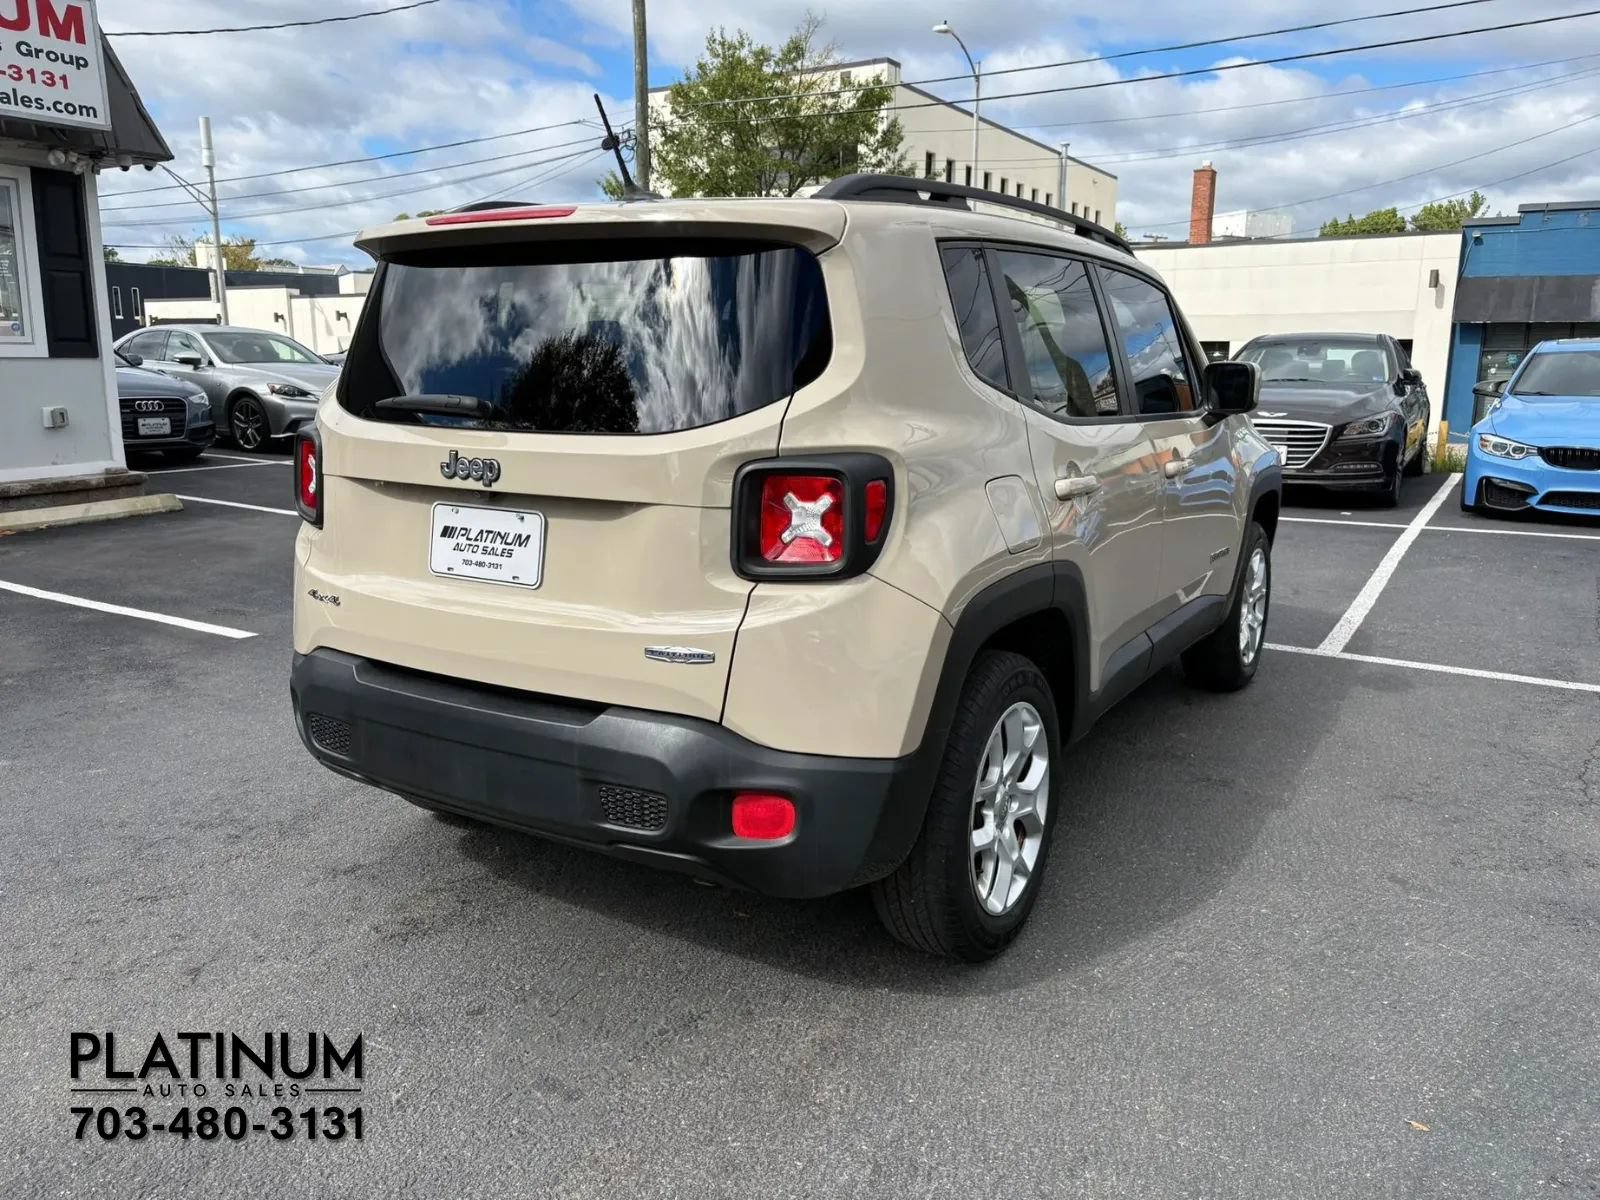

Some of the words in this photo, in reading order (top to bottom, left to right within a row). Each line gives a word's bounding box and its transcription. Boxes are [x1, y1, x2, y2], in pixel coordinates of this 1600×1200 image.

[16, 41, 88, 70] Group
[440, 450, 501, 487] Jeep
[456, 527, 531, 548] PLATINUM
[453, 542, 480, 554] AUTO
[481, 546, 514, 558] SALES
[461, 559, 502, 570] 703-480-3131
